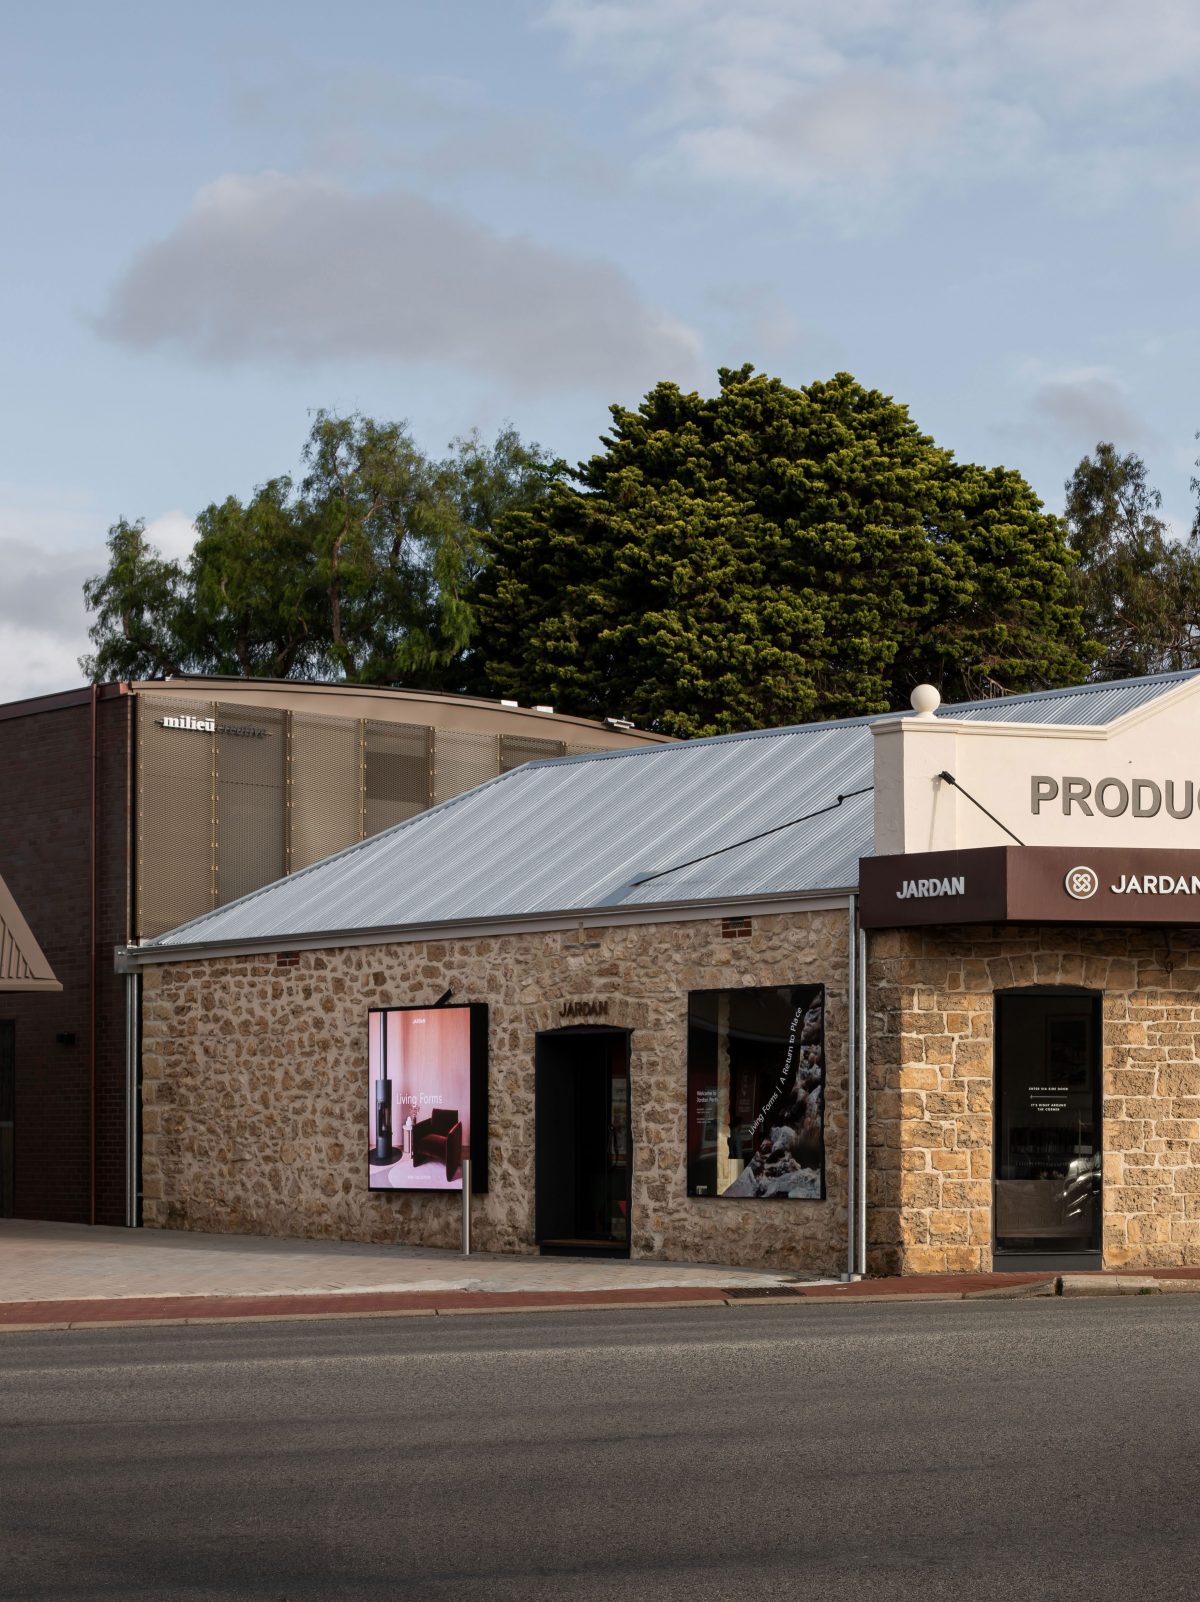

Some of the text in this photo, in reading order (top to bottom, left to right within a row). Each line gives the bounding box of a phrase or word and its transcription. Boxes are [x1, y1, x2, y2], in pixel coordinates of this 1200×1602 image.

[896, 877, 965, 899] JARDAN
[559, 1001, 609, 1018] JARDAN
[790, 1007, 802, 1032] Place
[789, 1034, 796, 1044] to
[782, 1046, 794, 1075] Return
[779, 1076, 786, 1085] A
[396, 1092, 443, 1108] Living Forms
[762, 1093, 779, 1115] Forms
[748, 1113, 764, 1136] Living
